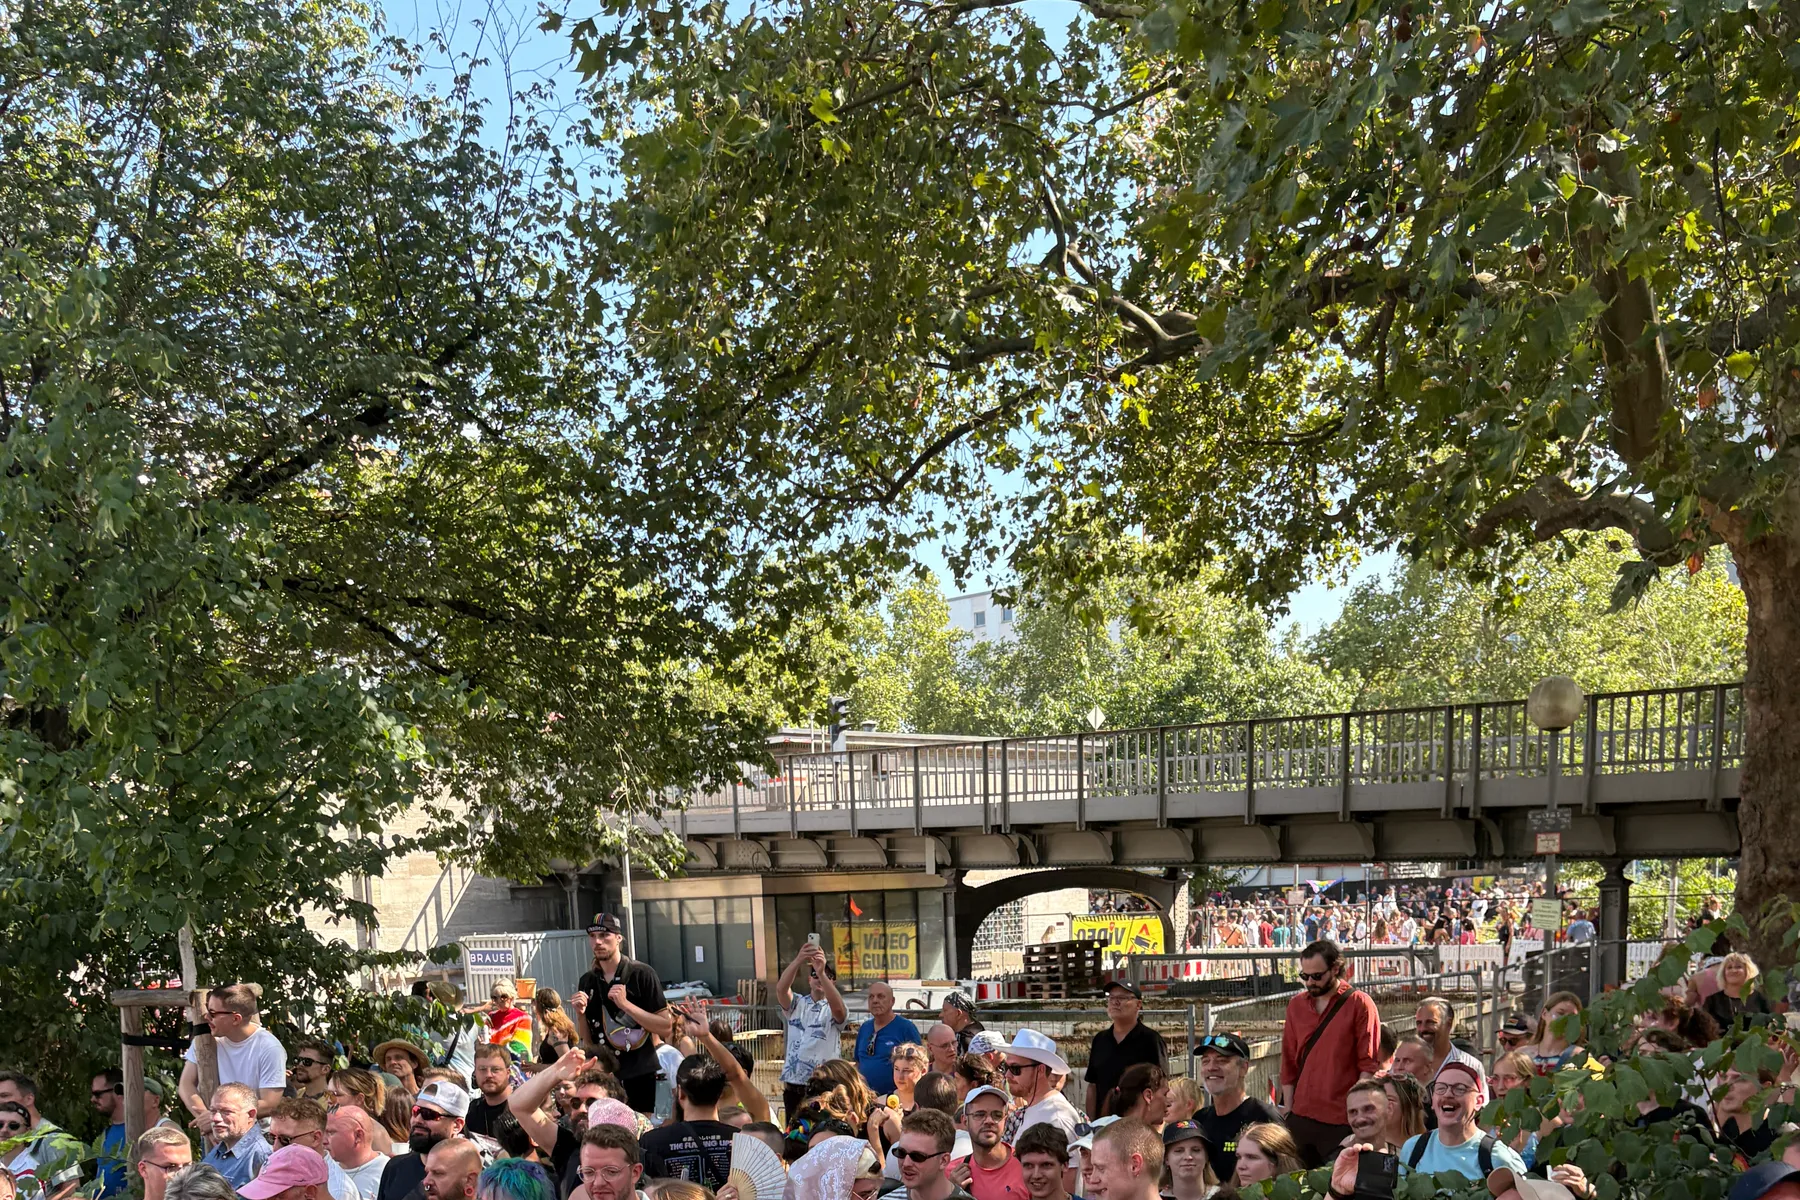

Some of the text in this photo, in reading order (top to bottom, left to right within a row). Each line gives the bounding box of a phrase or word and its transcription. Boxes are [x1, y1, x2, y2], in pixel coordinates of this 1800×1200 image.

[470, 953, 513, 963] BRAUER
[862, 953, 909, 970] GUARD
[669, 1142, 684, 1151] THE
